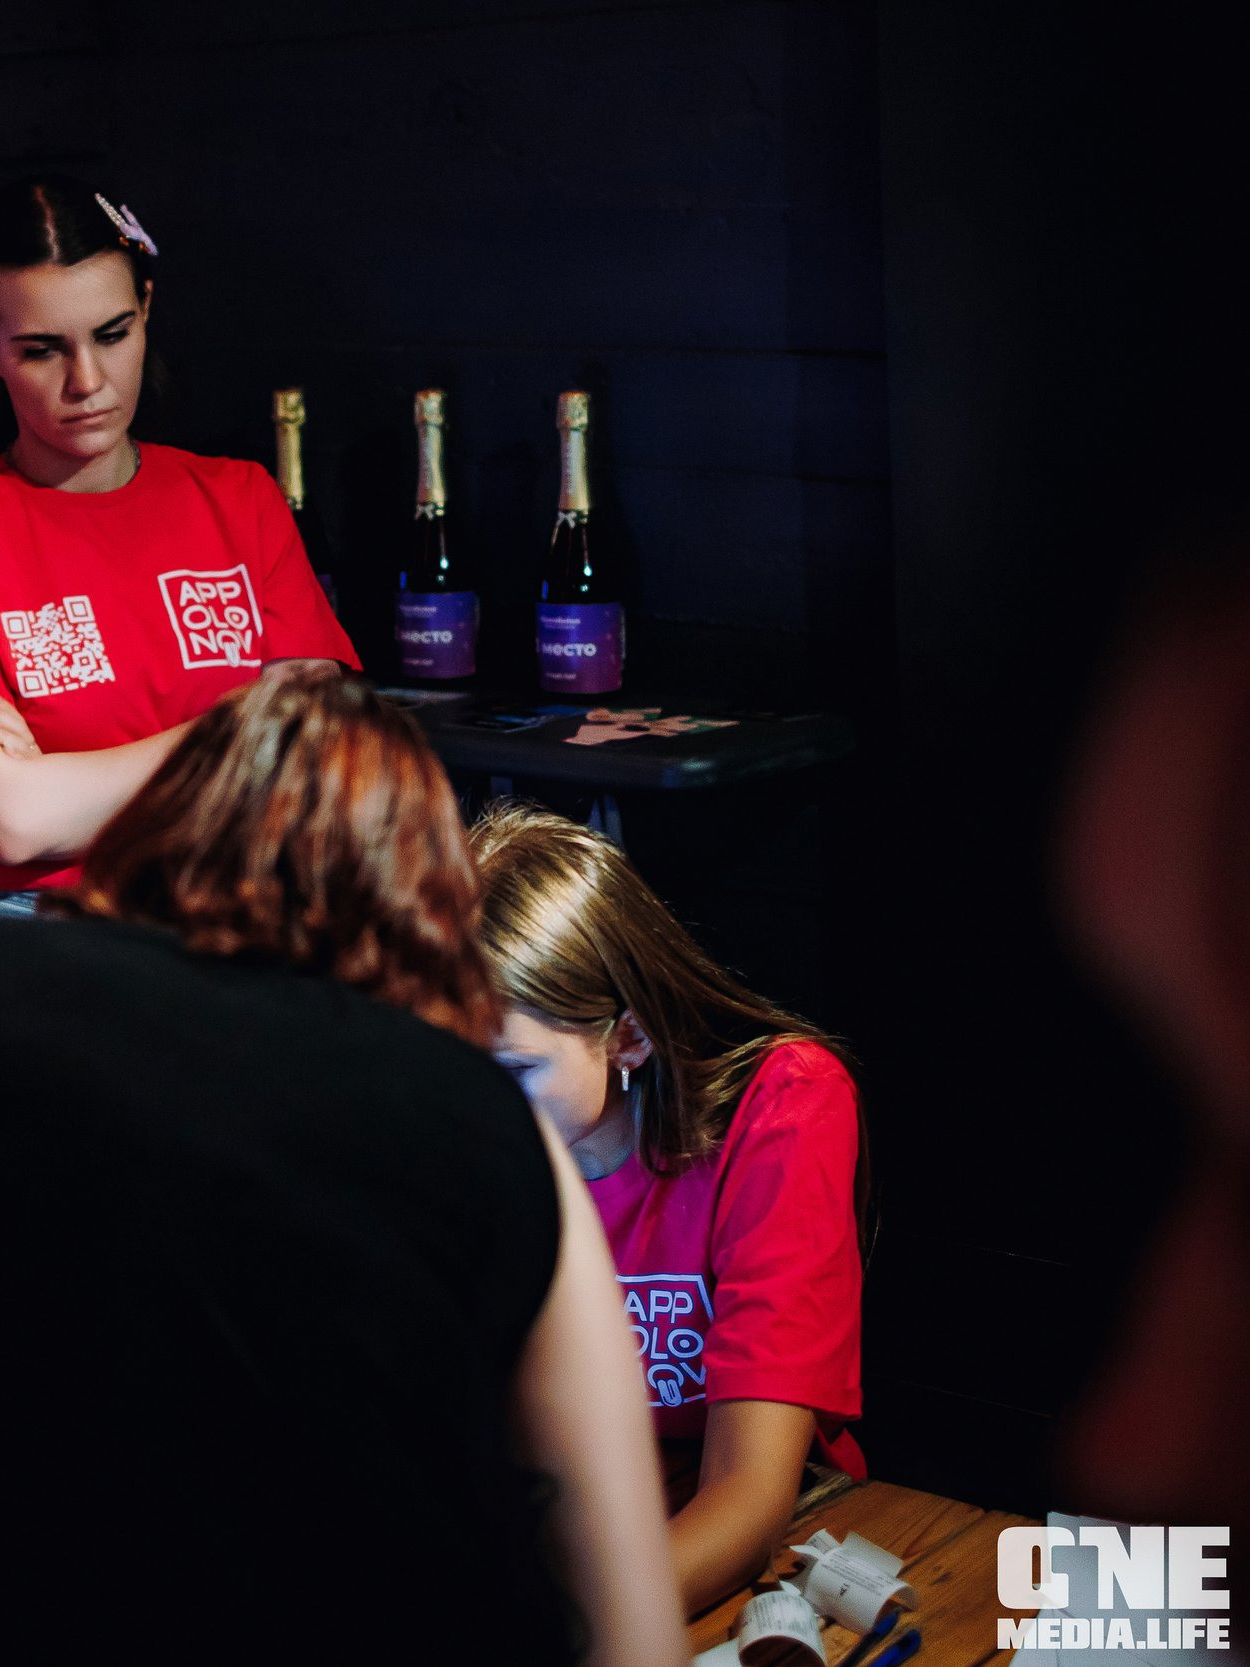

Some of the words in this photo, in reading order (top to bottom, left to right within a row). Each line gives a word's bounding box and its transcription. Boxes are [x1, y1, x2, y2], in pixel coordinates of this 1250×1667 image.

[179, 580, 241, 607] APP
[182, 604, 249, 630] OLO
[624, 1290, 693, 1324] APP
